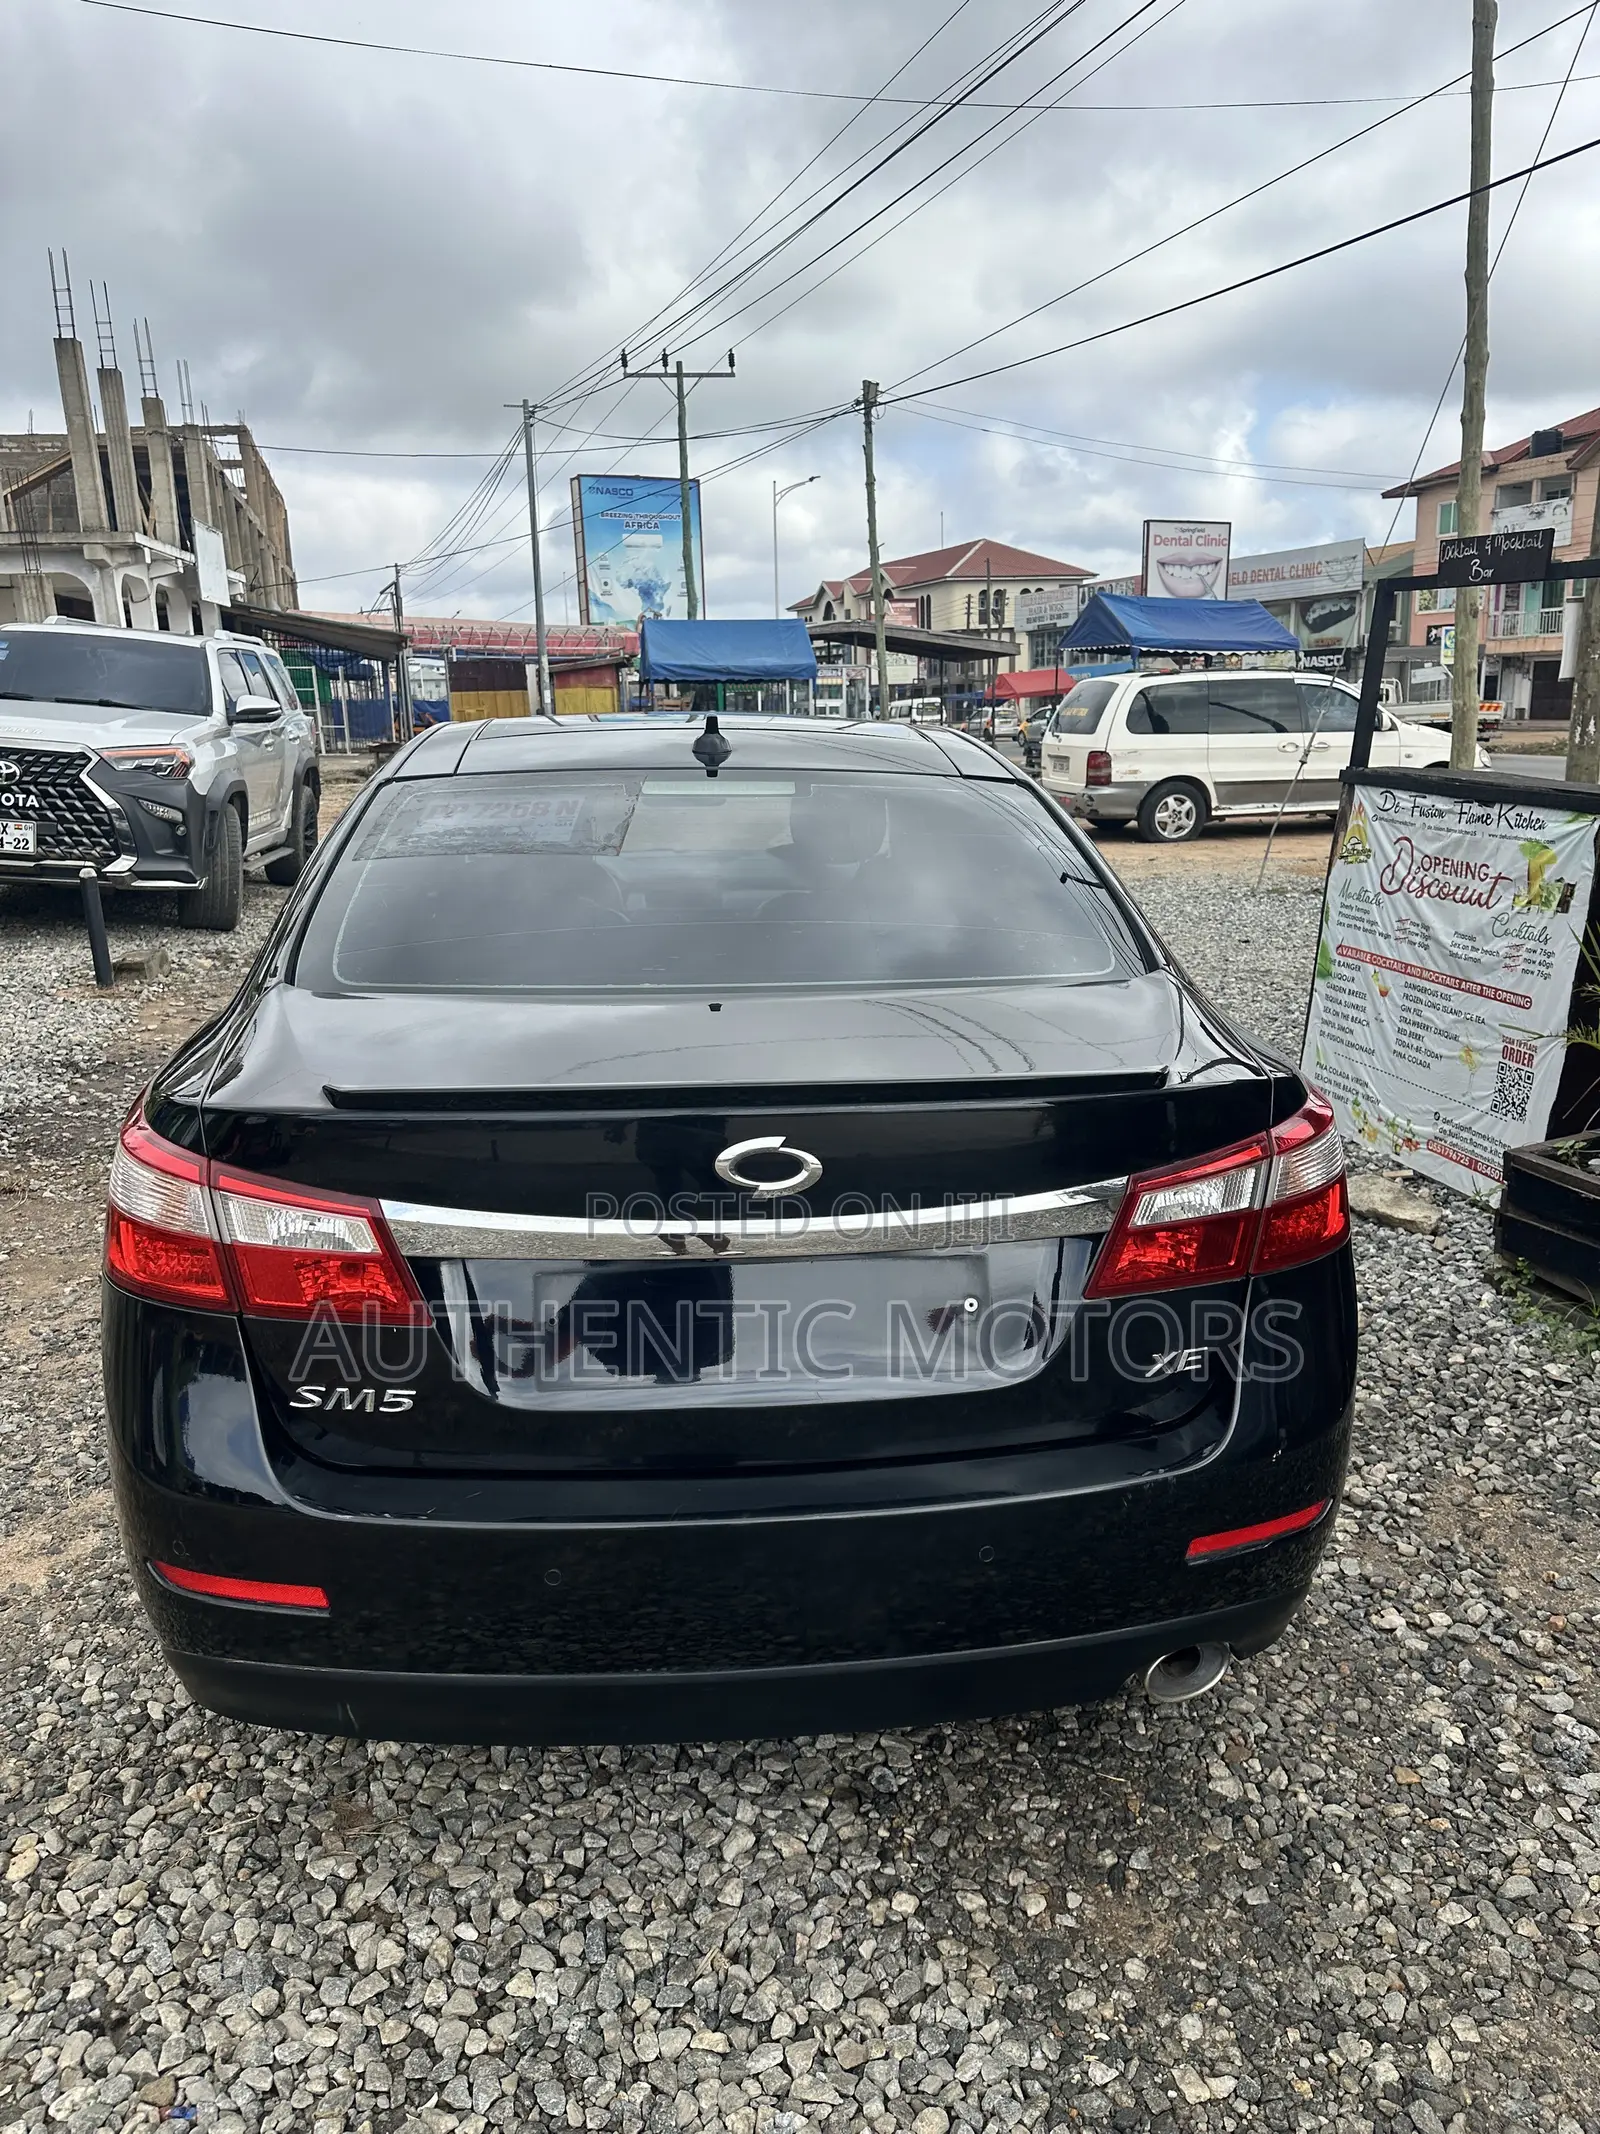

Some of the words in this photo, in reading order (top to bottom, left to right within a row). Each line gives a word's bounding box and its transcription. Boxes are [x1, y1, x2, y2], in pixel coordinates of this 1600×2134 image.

[596, 487, 633, 496] NASCO
[624, 521, 660, 530] AFRICA
[1154, 534, 1192, 546] Dental
[1196, 534, 1228, 546] Clinic
[1440, 538, 1478, 563] Cocktail
[1494, 531, 1544, 556] Mocktail
[1250, 566, 1286, 584] DENTAL
[1290, 561, 1323, 579] CLINIC
[1468, 559, 1494, 582] Bar
[1303, 654, 1344, 668] NASCO
[0, 792, 40, 808] OTA
[1409, 794, 1447, 820] Fusion
[1454, 800, 1494, 827] Flame
[1497, 802, 1548, 832] Kitchen
[1380, 836, 1513, 910] Discount
[1420, 854, 1490, 882] OPENING
[1490, 912, 1552, 946] Cocktails
[1481, 946, 1500, 958] beach
[1338, 960, 1361, 972] BANGER
[1336, 945, 1370, 962] AVAILABLE
[1372, 954, 1405, 973] COCKTAILS
[1406, 966, 1420, 980] AND
[1421, 969, 1460, 989] MOCKTAILS
[1460, 980, 1482, 996] AFTER
[1482, 986, 1496, 1000] THE
[1496, 989, 1531, 1008] OPENING
[1326, 981, 1347, 996] GARDEN
[1348, 988, 1368, 1000] BREEZE
[1404, 981, 1438, 998] DANGEROUS
[1440, 992, 1452, 1002] KISS
[1344, 1000, 1367, 1014] SUNRISE
[1400, 1004, 1412, 1013] GIN
[1402, 992, 1423, 1006] FROZEN
[1424, 1000, 1440, 1012] LONG
[1441, 1005, 1462, 1018] ISLAND
[1475, 1016, 1486, 1026] TEA
[1340, 1010, 1350, 1020] THE
[1350, 1015, 1370, 1028] BEACH
[1399, 1016, 1432, 1033] STRAWBERRY
[1397, 1026, 1408, 1036] RED
[1408, 1032, 1426, 1043] BERRY
[1344, 1039, 1376, 1056] LEMONADE
[1395, 1038, 1444, 1061] TODAY-BE-TODAY
[1502, 1044, 1535, 1068] ORDER
[1407, 1055, 1432, 1070] COLADA
[1328, 1066, 1350, 1080] COLADA
[1428, 1140, 1470, 1166] 0551796725
[1146, 1346, 1208, 1378] XE
[289, 1386, 418, 1412] SM5
